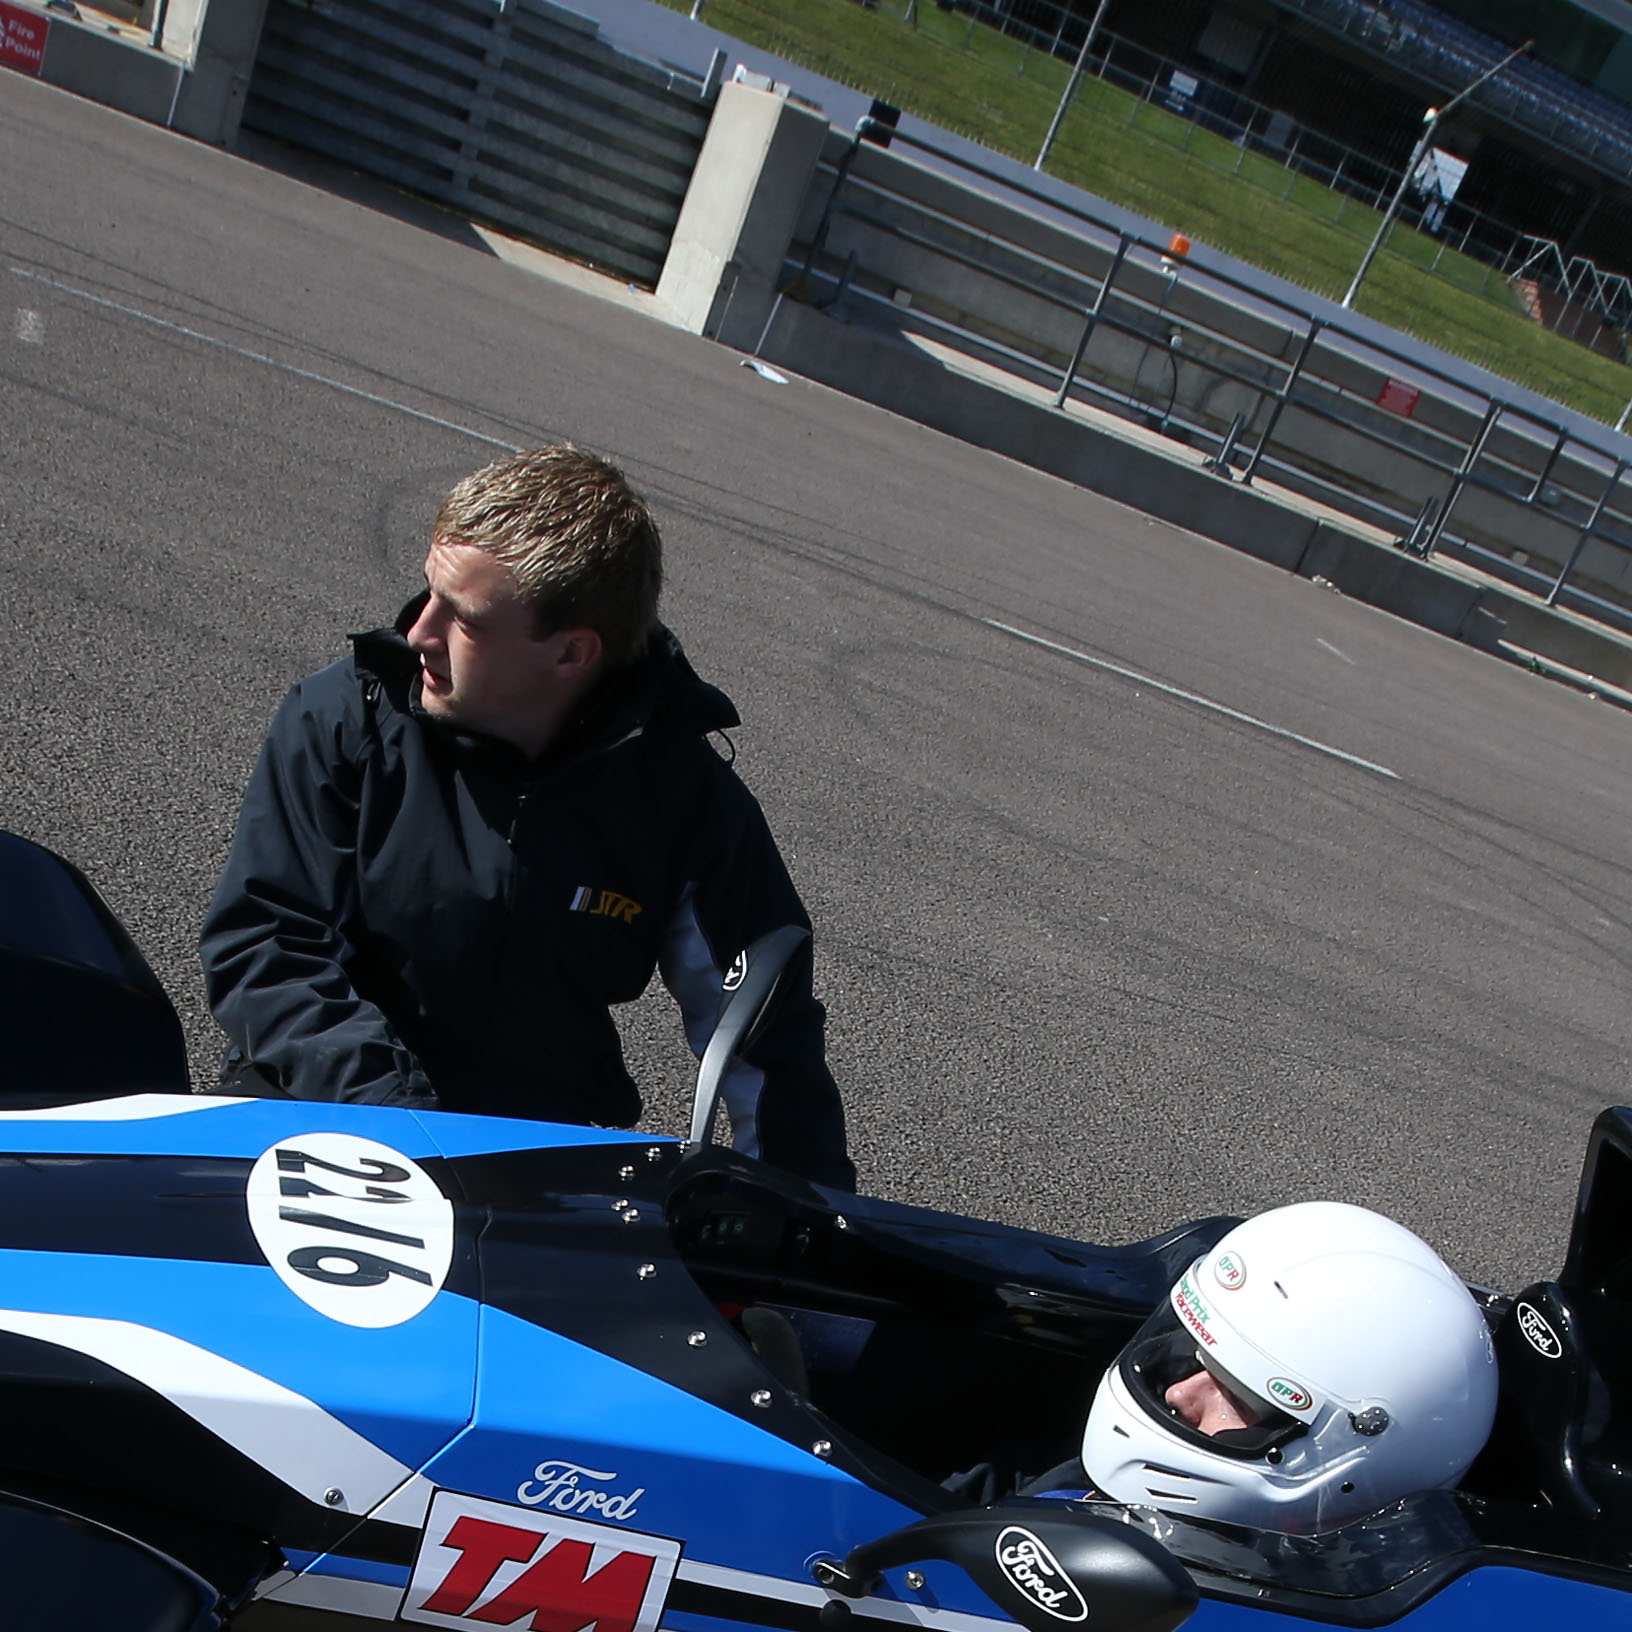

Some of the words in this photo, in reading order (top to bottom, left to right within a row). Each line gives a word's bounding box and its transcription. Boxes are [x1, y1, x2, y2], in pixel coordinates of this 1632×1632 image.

[5, 36, 41, 61] Point
[9, 20, 35, 40] Fire
[275, 1148, 434, 1288] 22/6
[1521, 1311, 1553, 1351] Ford
[518, 1460, 646, 1520] Ford
[1001, 1540, 1068, 1608] Ford
